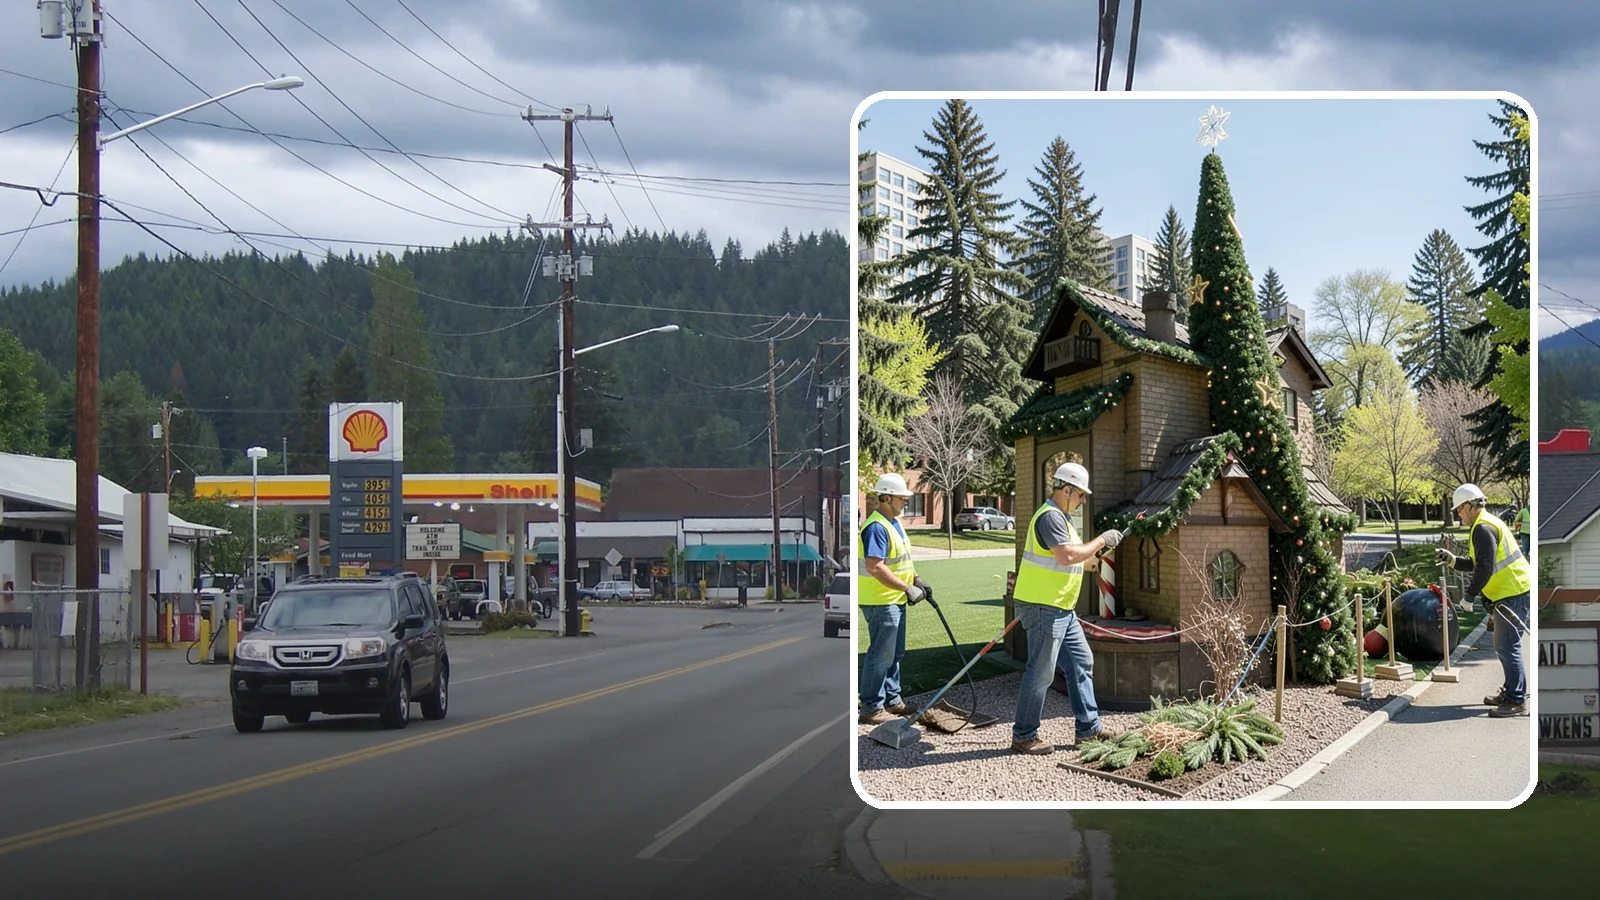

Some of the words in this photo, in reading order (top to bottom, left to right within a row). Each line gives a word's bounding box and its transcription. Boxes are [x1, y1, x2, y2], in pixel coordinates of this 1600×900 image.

[365, 480, 384, 490] 395
[490, 484, 547, 499] Shell
[365, 494, 384, 504] 405
[365, 508, 384, 518] 415
[365, 522, 384, 532] 429
[1538, 642, 1567, 666] AID
